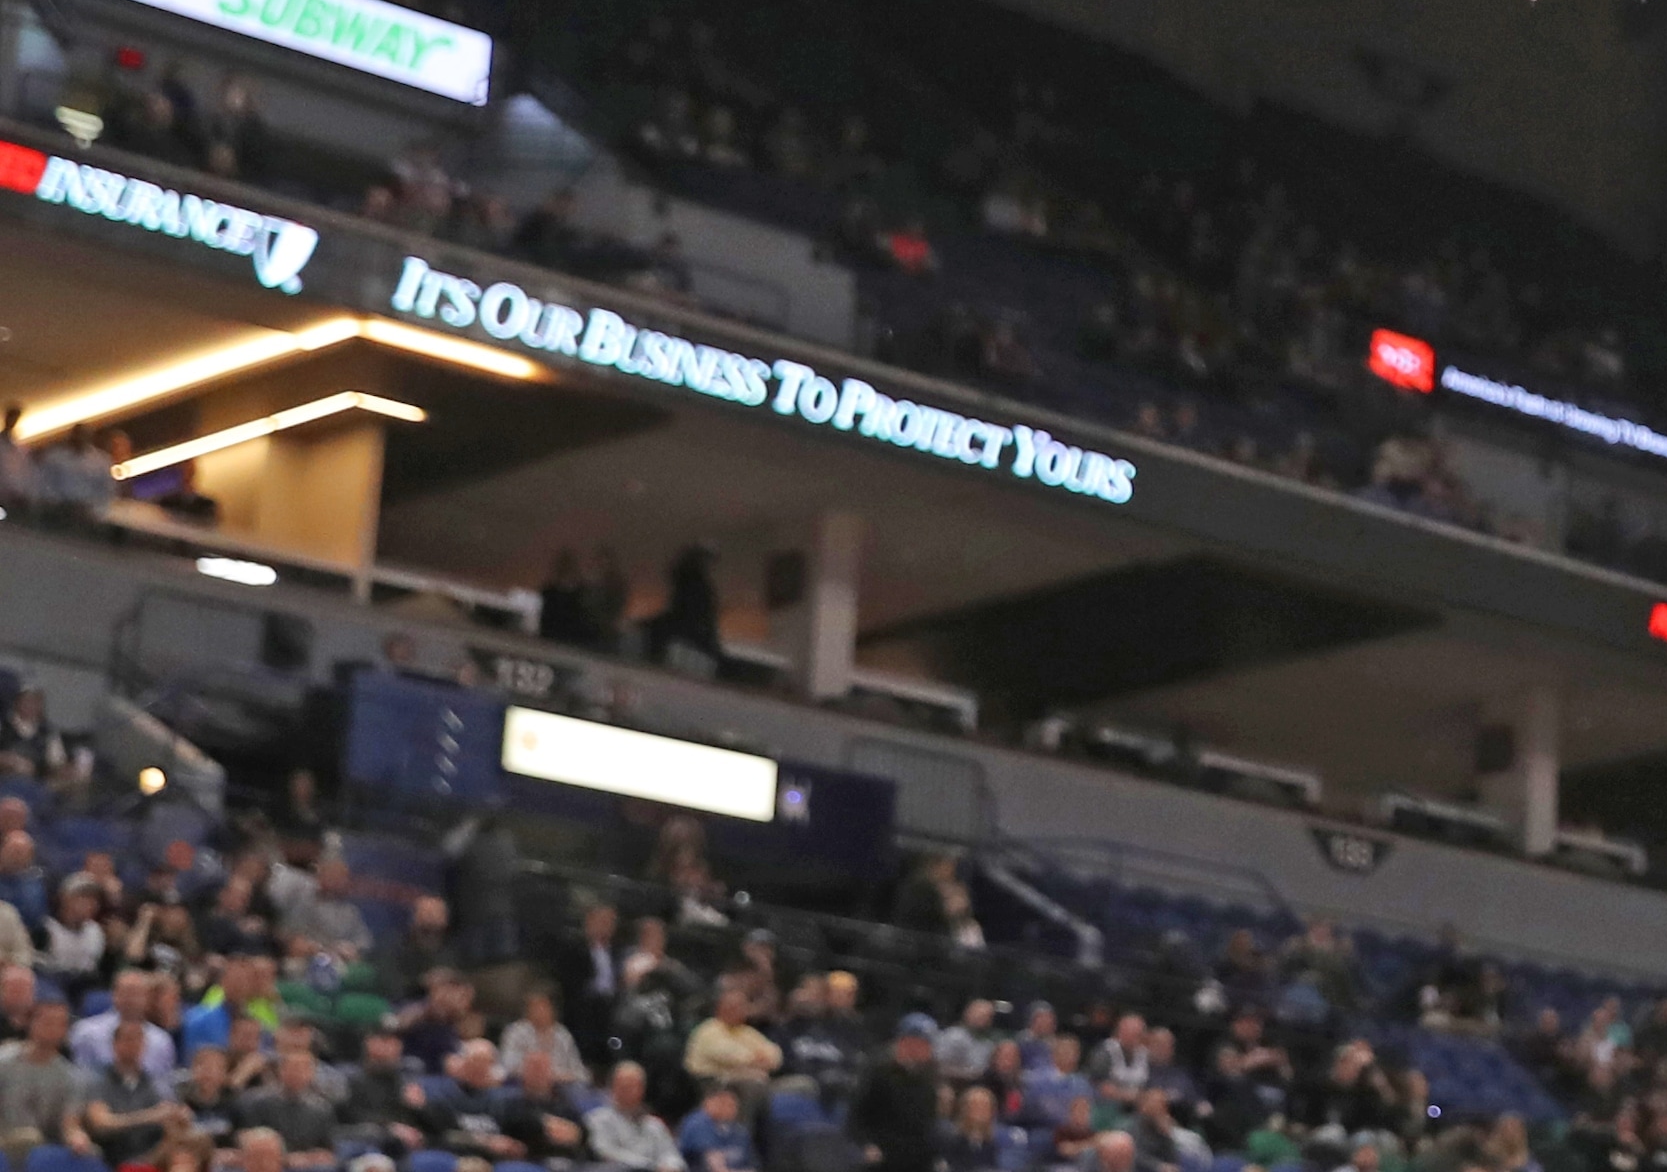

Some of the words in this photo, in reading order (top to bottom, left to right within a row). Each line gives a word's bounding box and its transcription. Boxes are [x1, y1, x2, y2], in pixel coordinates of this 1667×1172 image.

[36, 155, 262, 255] INSURANCE
[480, 282, 583, 356] OUR
[578, 308, 771, 407] BUSINESS
[773, 359, 838, 423] TO
[832, 378, 1013, 468] PROTECT
[1012, 425, 1136, 504] YOURS
